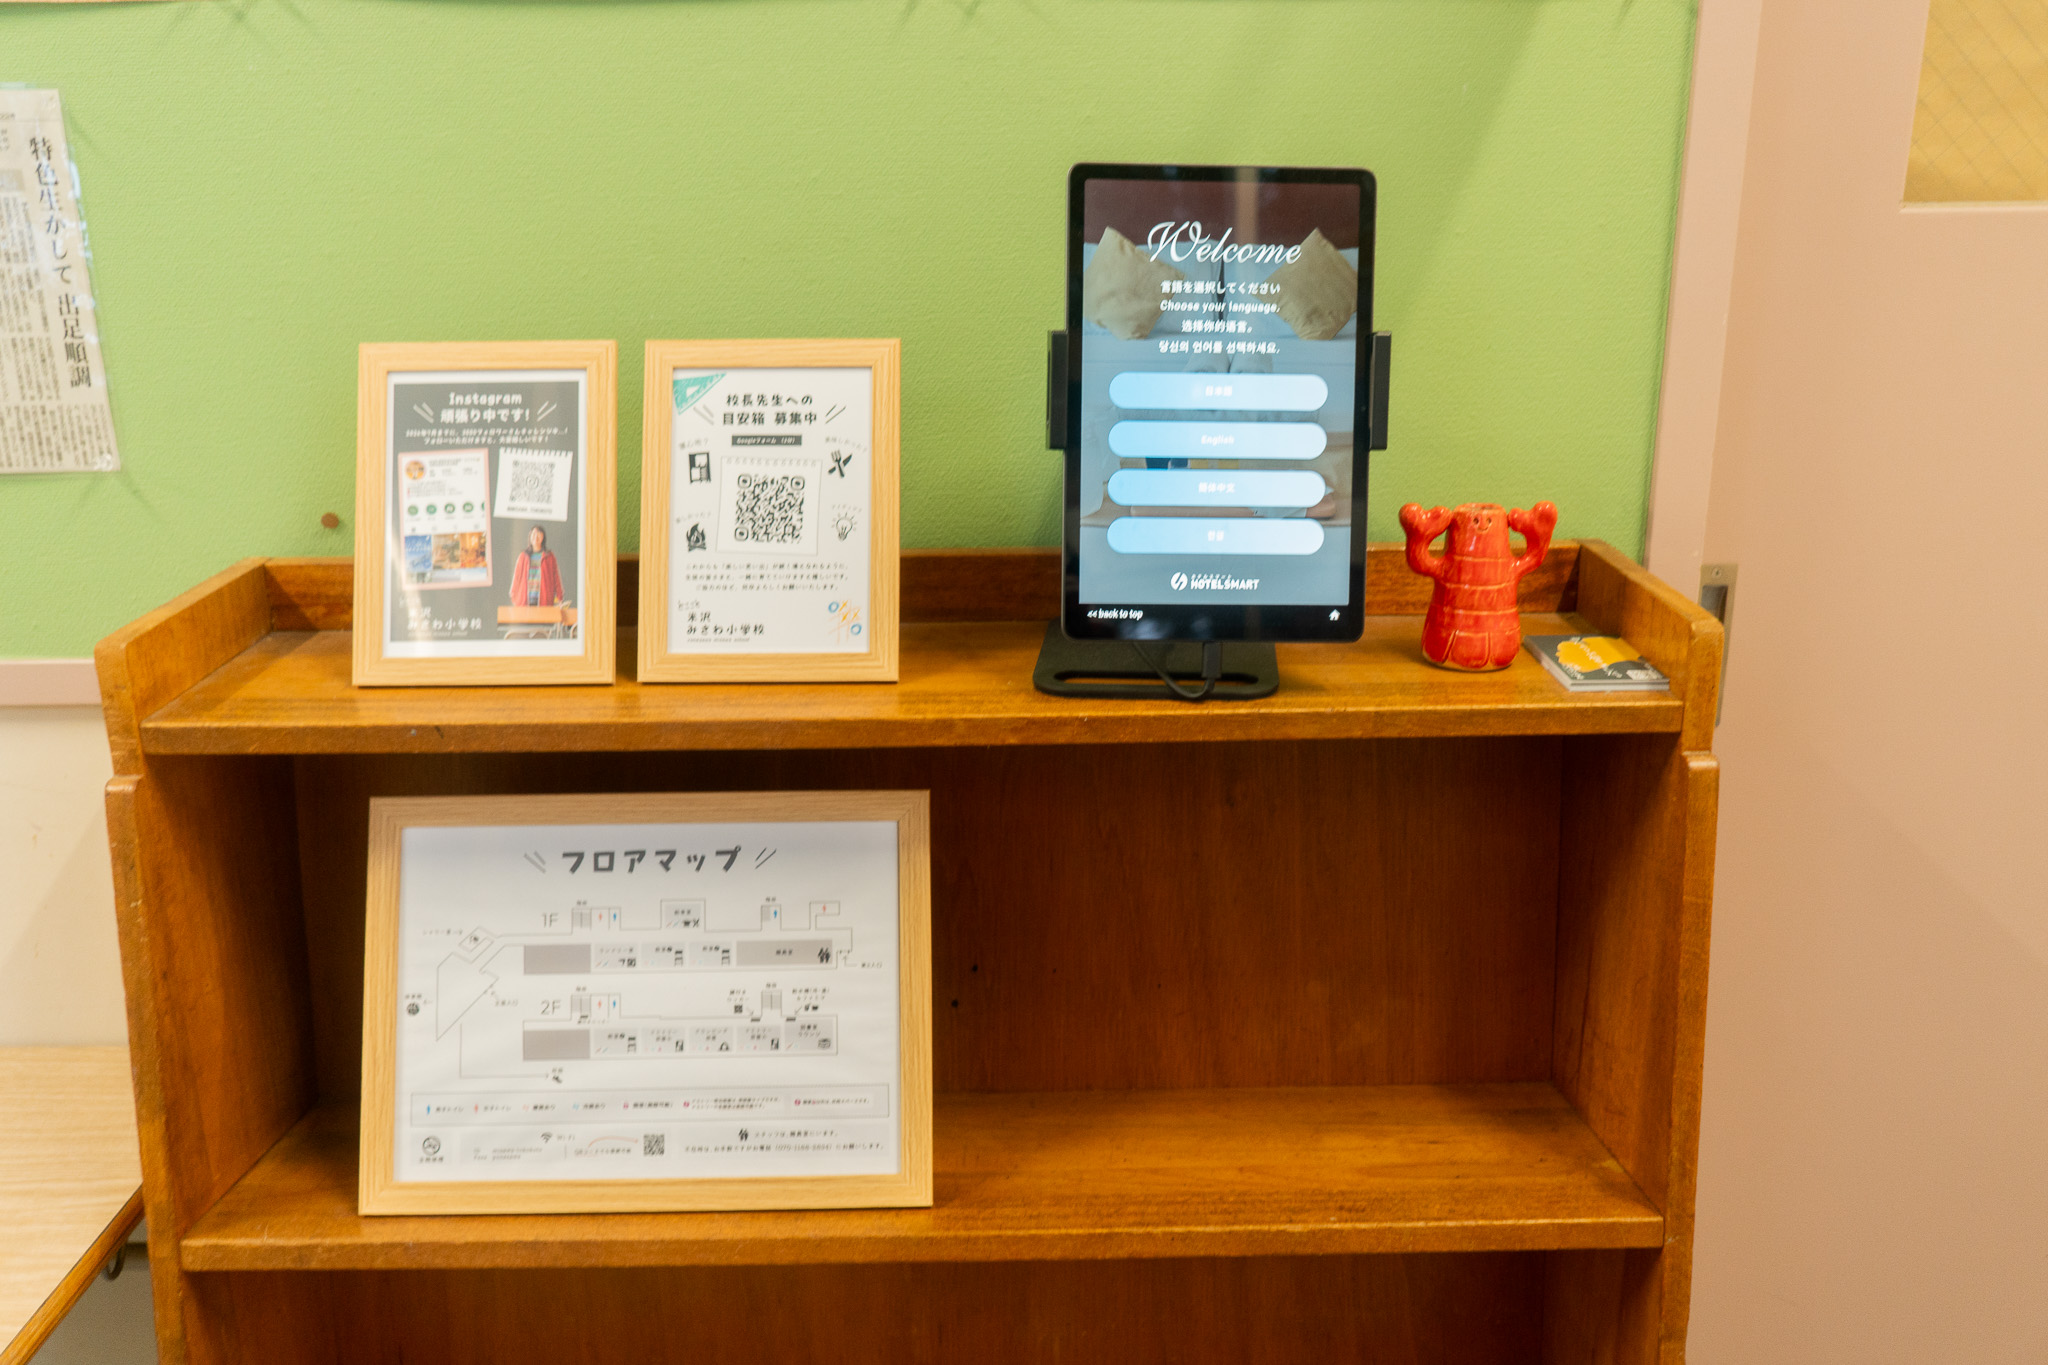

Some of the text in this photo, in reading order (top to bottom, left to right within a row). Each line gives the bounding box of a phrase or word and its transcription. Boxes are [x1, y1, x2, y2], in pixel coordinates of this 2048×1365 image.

[1147, 221, 1302, 264] Welcome
[30, 137, 91, 388] 特色生かして 出足順調
[1161, 280, 1281, 294] 言語を選択してください
[1160, 300, 1200, 311] Choose
[1202, 302, 1227, 314] your
[1159, 340, 1189, 353] 당신의
[1192, 341, 1222, 354] 언어를
[449, 392, 522, 406] Instagram
[726, 393, 813, 407] 校長先生への
[723, 411, 818, 426] 目安箱 募集中
[1201, 434, 1234, 446] English
[1191, 578, 1260, 590] HOTELSMART
[688, 611, 711, 623] 米沢
[1098, 608, 1118, 619] back
[1119, 609, 1129, 619] to
[1129, 609, 1144, 621] top
[407, 618, 482, 631] みさわ小学校
[687, 624, 764, 636] みさわ小学校
[562, 845, 742, 874] フロアマップ
[543, 913, 559, 928] 1F
[541, 1000, 561, 1015] 2F
